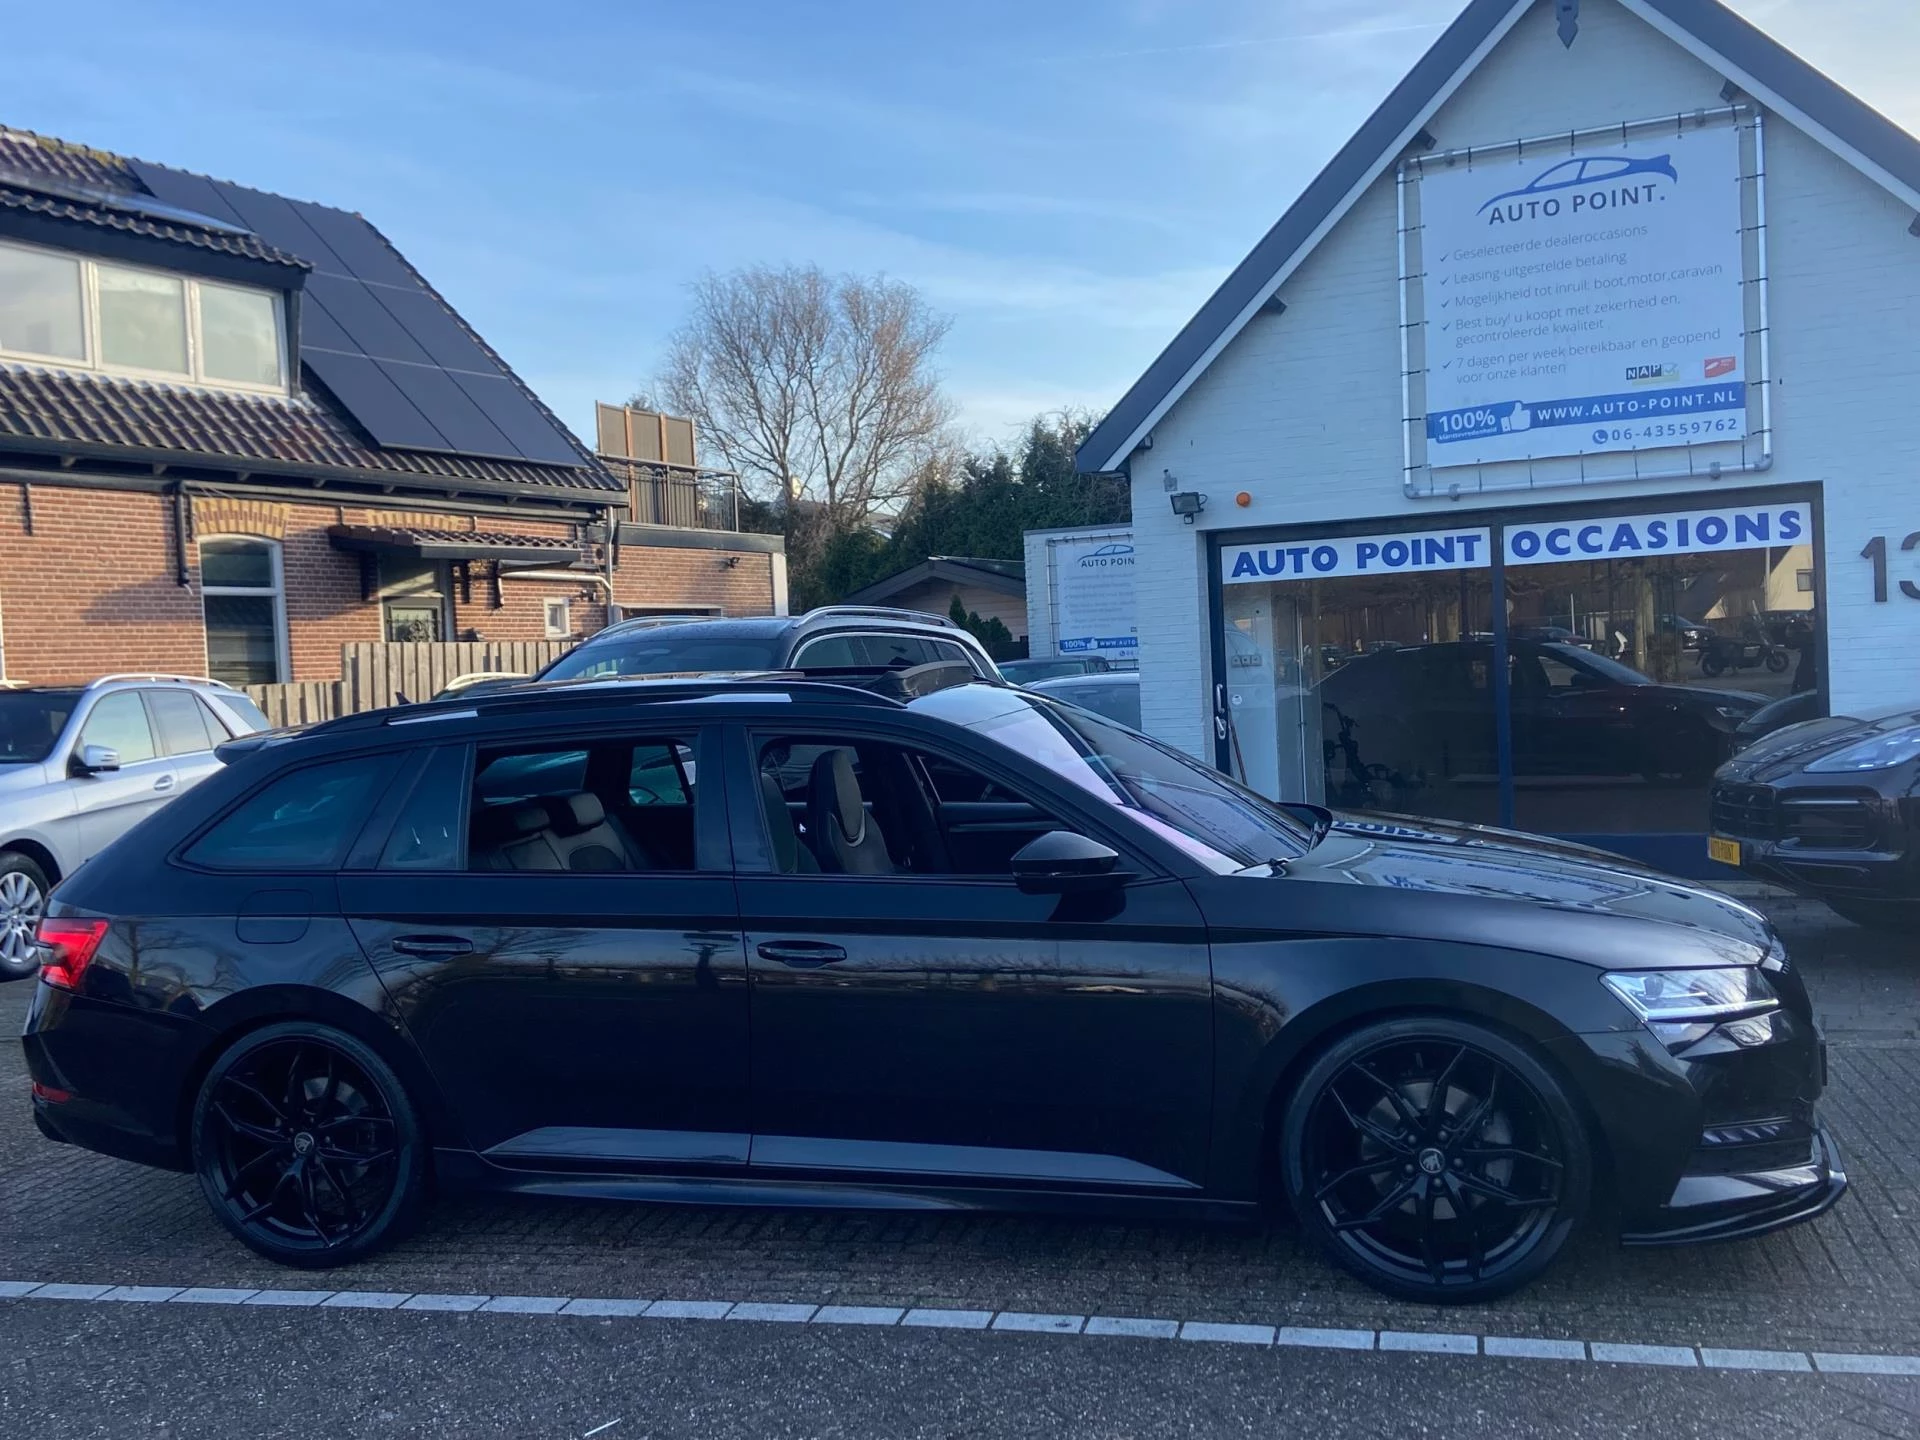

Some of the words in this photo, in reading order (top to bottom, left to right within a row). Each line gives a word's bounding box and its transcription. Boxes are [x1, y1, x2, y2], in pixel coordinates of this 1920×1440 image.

[1489, 198, 1560, 225] AUTO
[1454, 239, 1541, 261] Geselecteerde
[1545, 225, 1648, 248] dealeroccasions
[1576, 252, 1628, 268] betaling
[1455, 287, 1531, 308] Mogelijkheid
[1535, 285, 1552, 297] tot
[1456, 316, 1482, 330] Best
[1514, 314, 1522, 323] u
[1527, 307, 1561, 321] koopt
[1566, 304, 1589, 316] met
[1594, 295, 1657, 314] zekerheid
[1456, 325, 1549, 349] gecontroleerde
[1553, 318, 1604, 333] kwaliteit
[1457, 357, 1464, 369] 7
[1467, 353, 1505, 369] dagen
[1509, 351, 1528, 366] per
[1532, 347, 1565, 360] week
[1569, 339, 1636, 356] bereikbaar
[1640, 338, 1658, 349] en
[1661, 328, 1721, 349] geopend
[1457, 372, 1484, 384] voor
[1487, 368, 1517, 381] onze
[1521, 362, 1566, 378] klanten
[1627, 364, 1661, 380] NAP
[1537, 390, 1737, 420] WWW.AUTO-POINT.NL
[1440, 409, 1496, 432] 100%
[1612, 418, 1737, 441] 06-43559762
[1510, 510, 1802, 558] OCCASIONS
[1081, 559, 1106, 568] AUTO
[1231, 545, 1338, 578] AUTO
[1356, 534, 1482, 569] POINT
